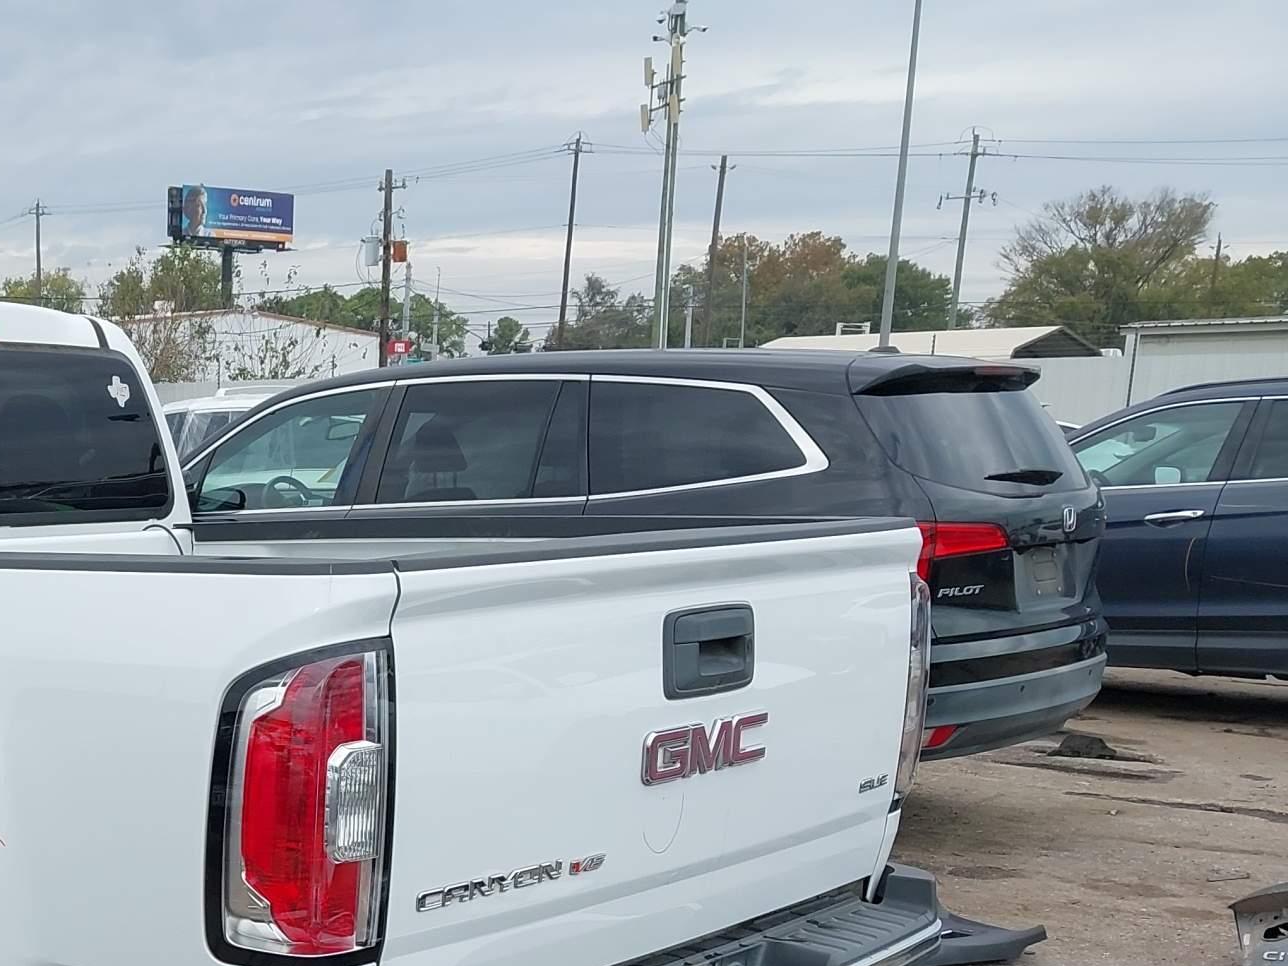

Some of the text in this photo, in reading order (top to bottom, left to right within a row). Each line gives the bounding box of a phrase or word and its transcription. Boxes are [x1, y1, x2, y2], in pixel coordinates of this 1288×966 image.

[239, 195, 272, 208] centrum
[937, 584, 985, 598] PILOT
[641, 709, 768, 786] GMC
[858, 773, 889, 794] SLE
[415, 858, 563, 912] CANYON
